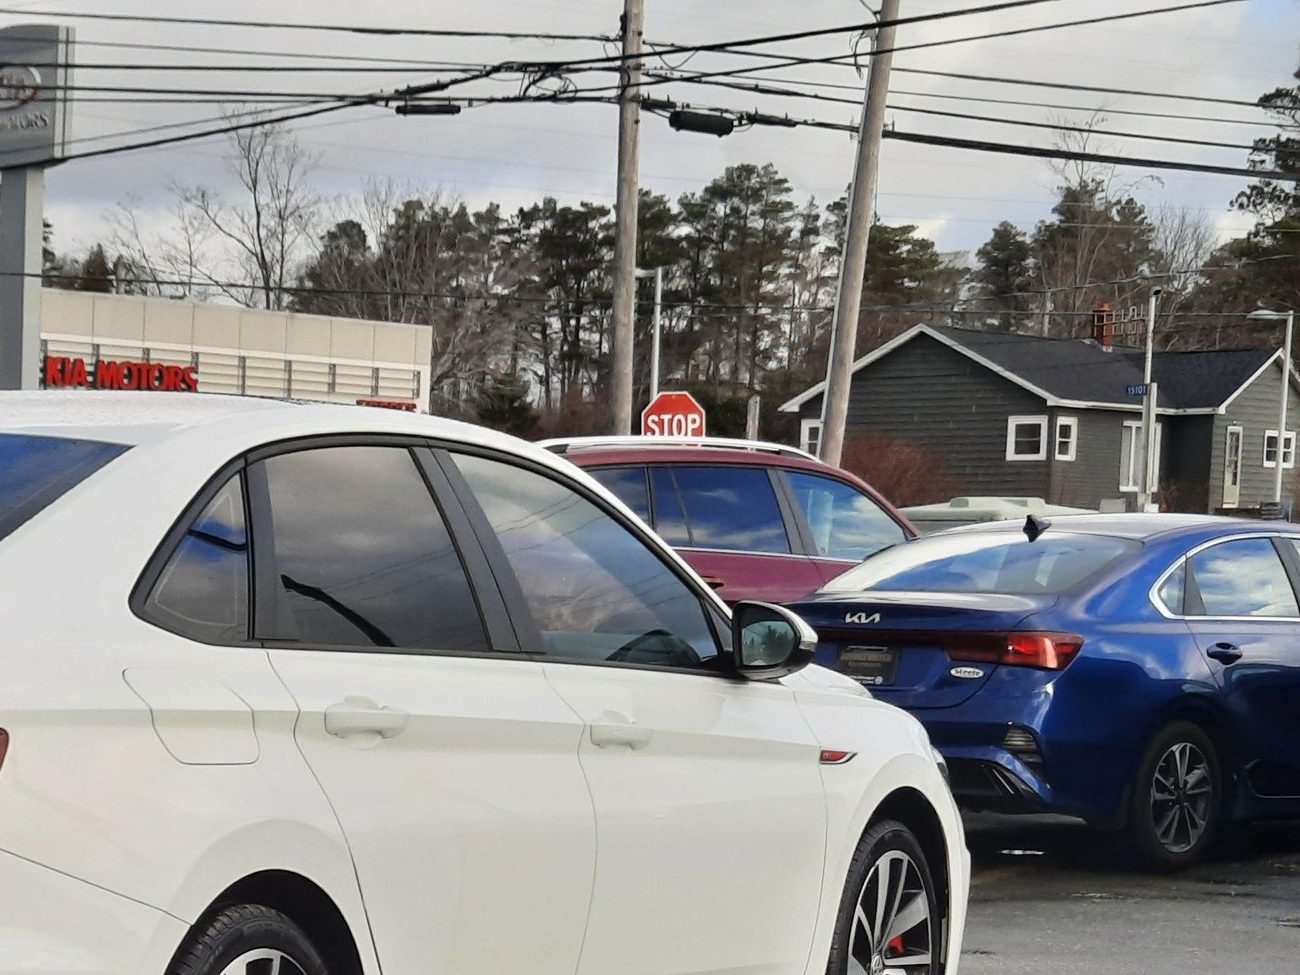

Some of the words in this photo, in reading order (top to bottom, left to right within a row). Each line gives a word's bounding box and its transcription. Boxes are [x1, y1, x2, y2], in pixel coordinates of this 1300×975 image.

[45, 355, 89, 388] KIA
[96, 359, 199, 392] MOTORS
[647, 413, 700, 437] STOP
